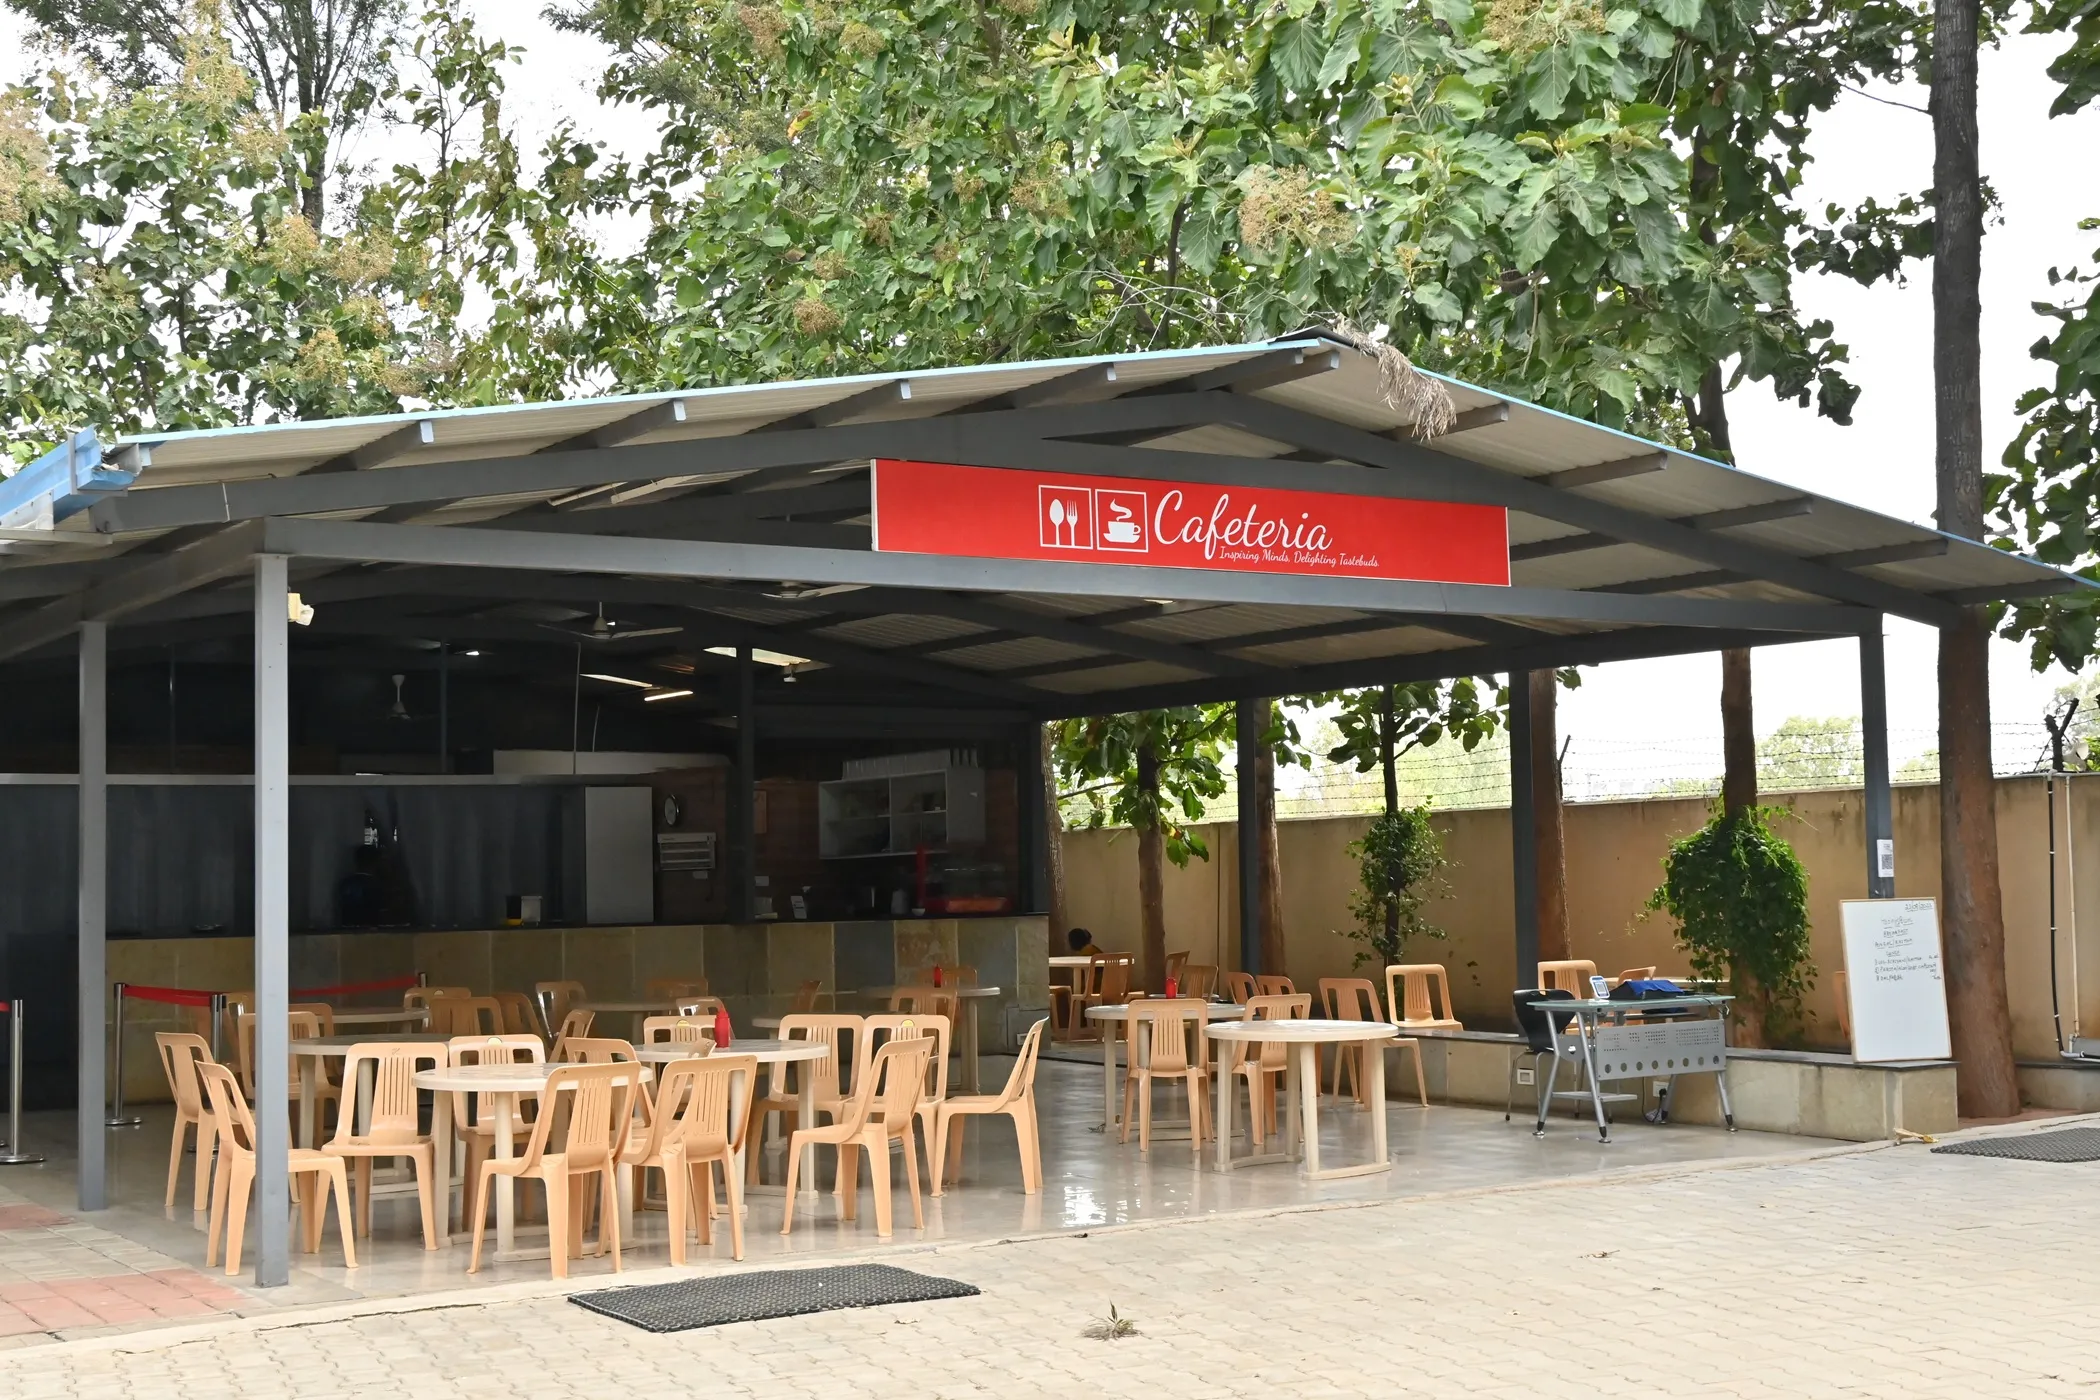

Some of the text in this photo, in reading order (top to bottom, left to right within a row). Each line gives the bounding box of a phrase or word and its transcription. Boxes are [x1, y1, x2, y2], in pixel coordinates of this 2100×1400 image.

[1154, 489, 1333, 560] Cafeteria
[1218, 546, 1260, 563] Inspiring
[1293, 551, 1336, 567] Delighting
[1339, 553, 1380, 567] Tastebuds.
